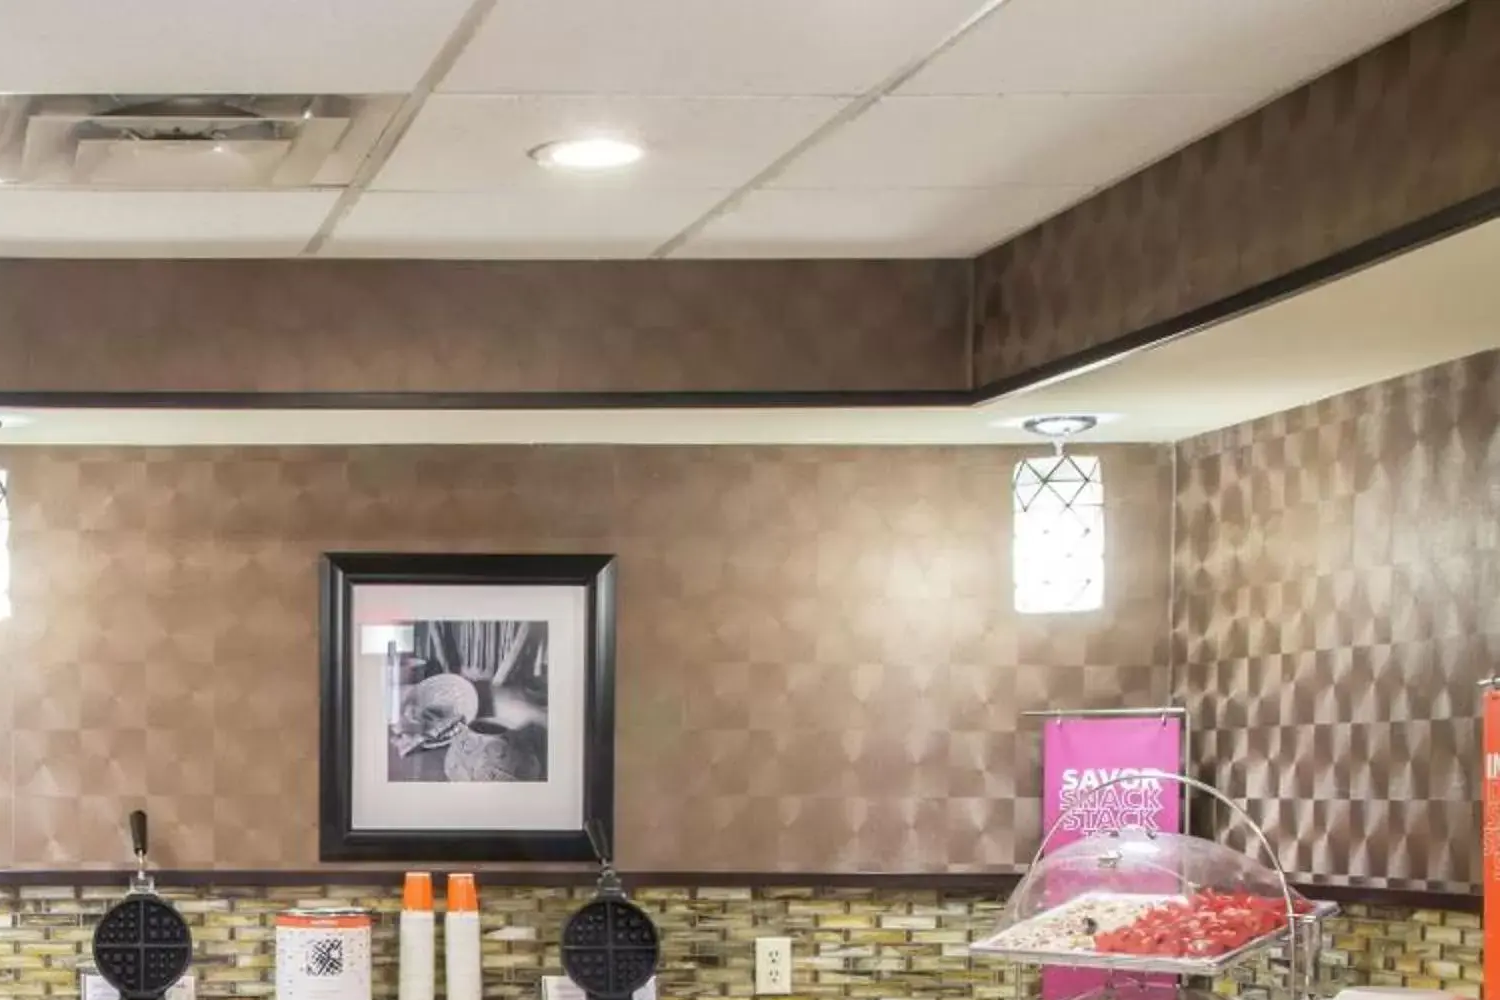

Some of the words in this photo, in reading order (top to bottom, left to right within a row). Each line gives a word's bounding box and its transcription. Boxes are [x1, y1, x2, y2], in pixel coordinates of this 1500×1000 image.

[1062, 767, 1162, 790] SAVOR
[1059, 788, 1164, 810] SNACK
[1064, 808, 1160, 831] STACK
